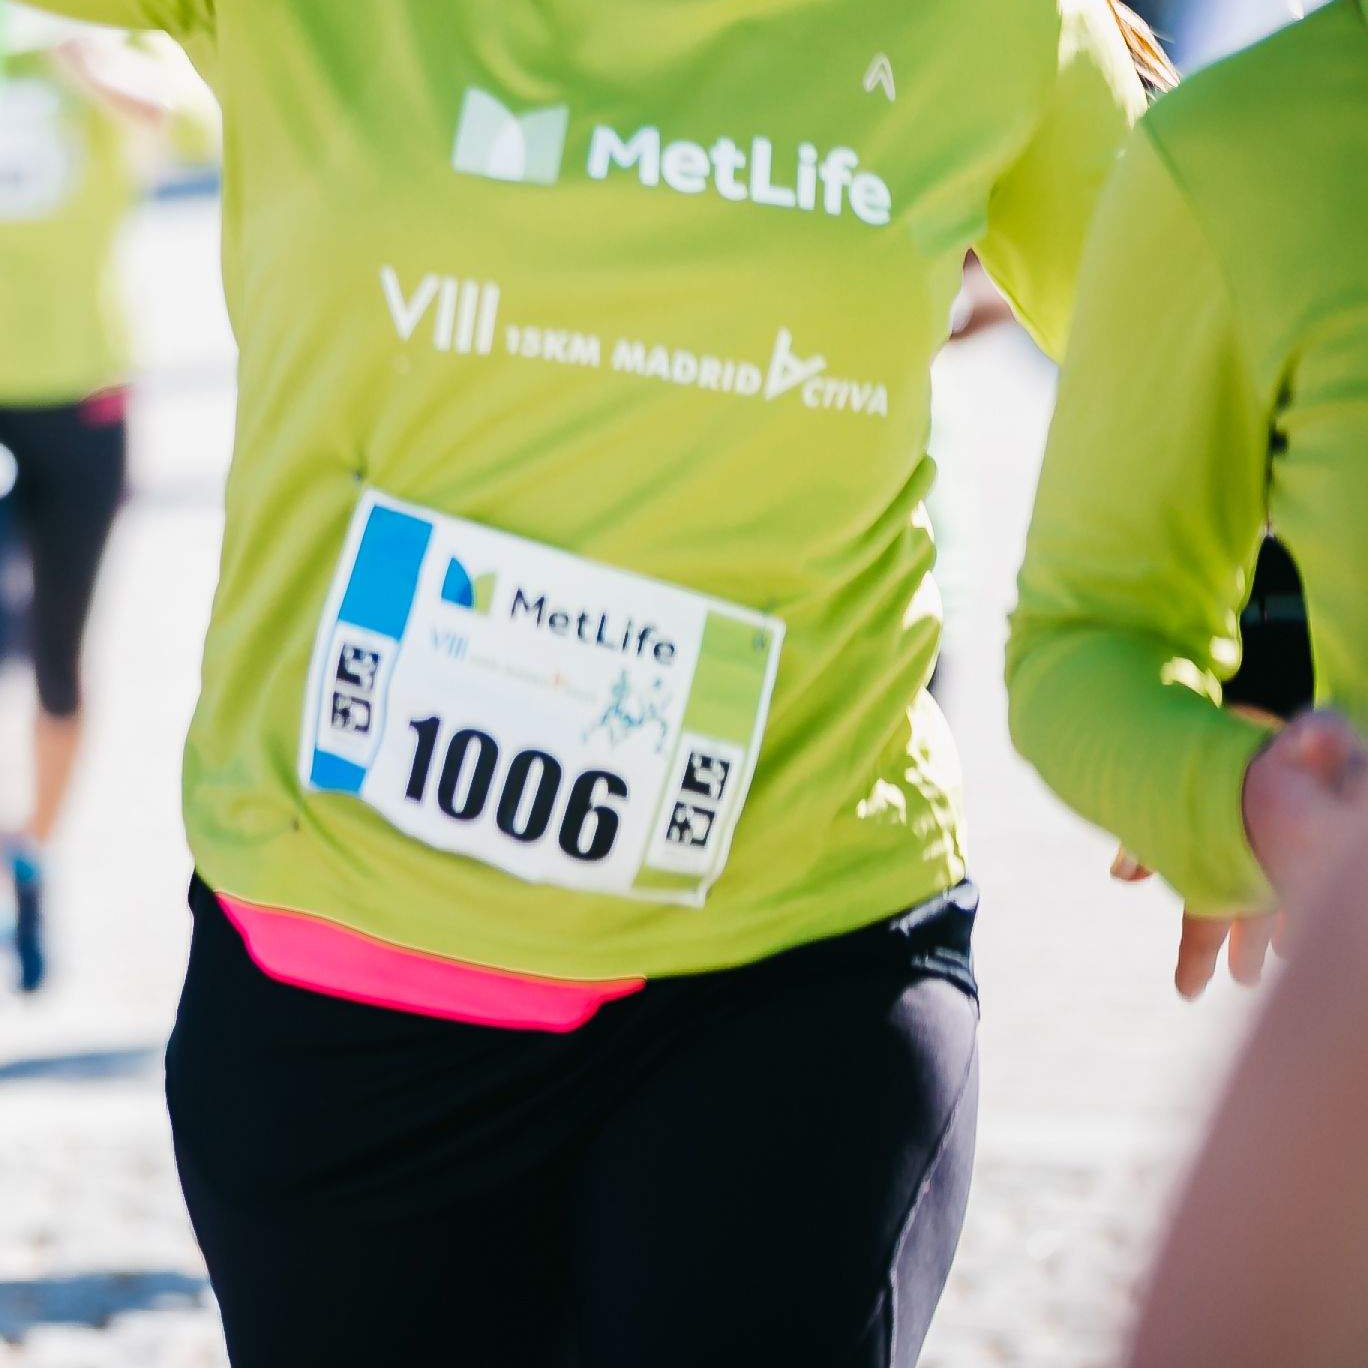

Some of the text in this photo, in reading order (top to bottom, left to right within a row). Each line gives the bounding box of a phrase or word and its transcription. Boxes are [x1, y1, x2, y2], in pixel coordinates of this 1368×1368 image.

[587, 123, 892, 226] MetLife
[380, 265, 501, 355] VIII
[612, 339, 762, 397] MADRID
[510, 587, 678, 666] MetLife
[405, 714, 629, 863] 1006
